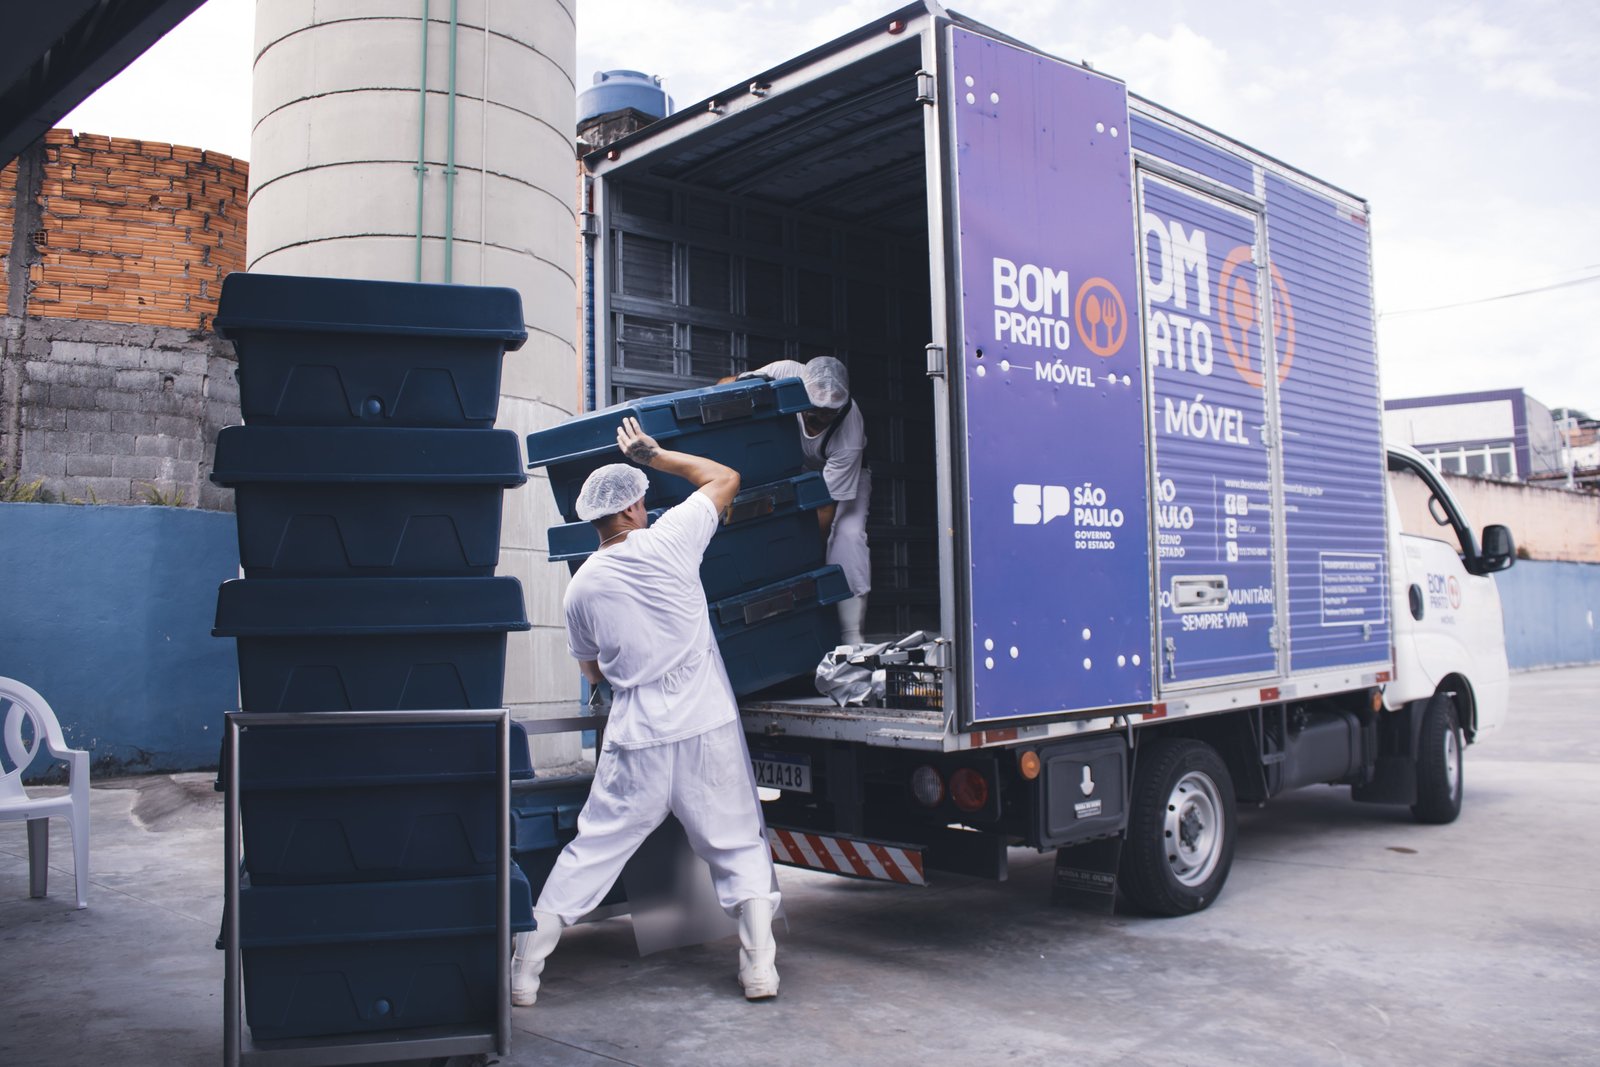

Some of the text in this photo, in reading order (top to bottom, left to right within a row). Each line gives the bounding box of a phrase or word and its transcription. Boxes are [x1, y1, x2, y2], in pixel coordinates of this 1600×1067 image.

[1144, 213, 1211, 316] OM
[993, 257, 1070, 318] BOM
[994, 309, 1070, 351] PRATO
[1148, 310, 1214, 376] ATO
[1035, 358, 1096, 388] MÓVEL
[1164, 393, 1250, 446] MÓVEL
[1073, 482, 1107, 507] SÃO
[1074, 507, 1125, 528] PAULO
[1074, 530, 1112, 540] GOVERNO
[1075, 541, 1116, 550] DO ESTADO
[1427, 572, 1448, 594] BOM
[1181, 611, 1249, 632] SEMPRE VIVA
